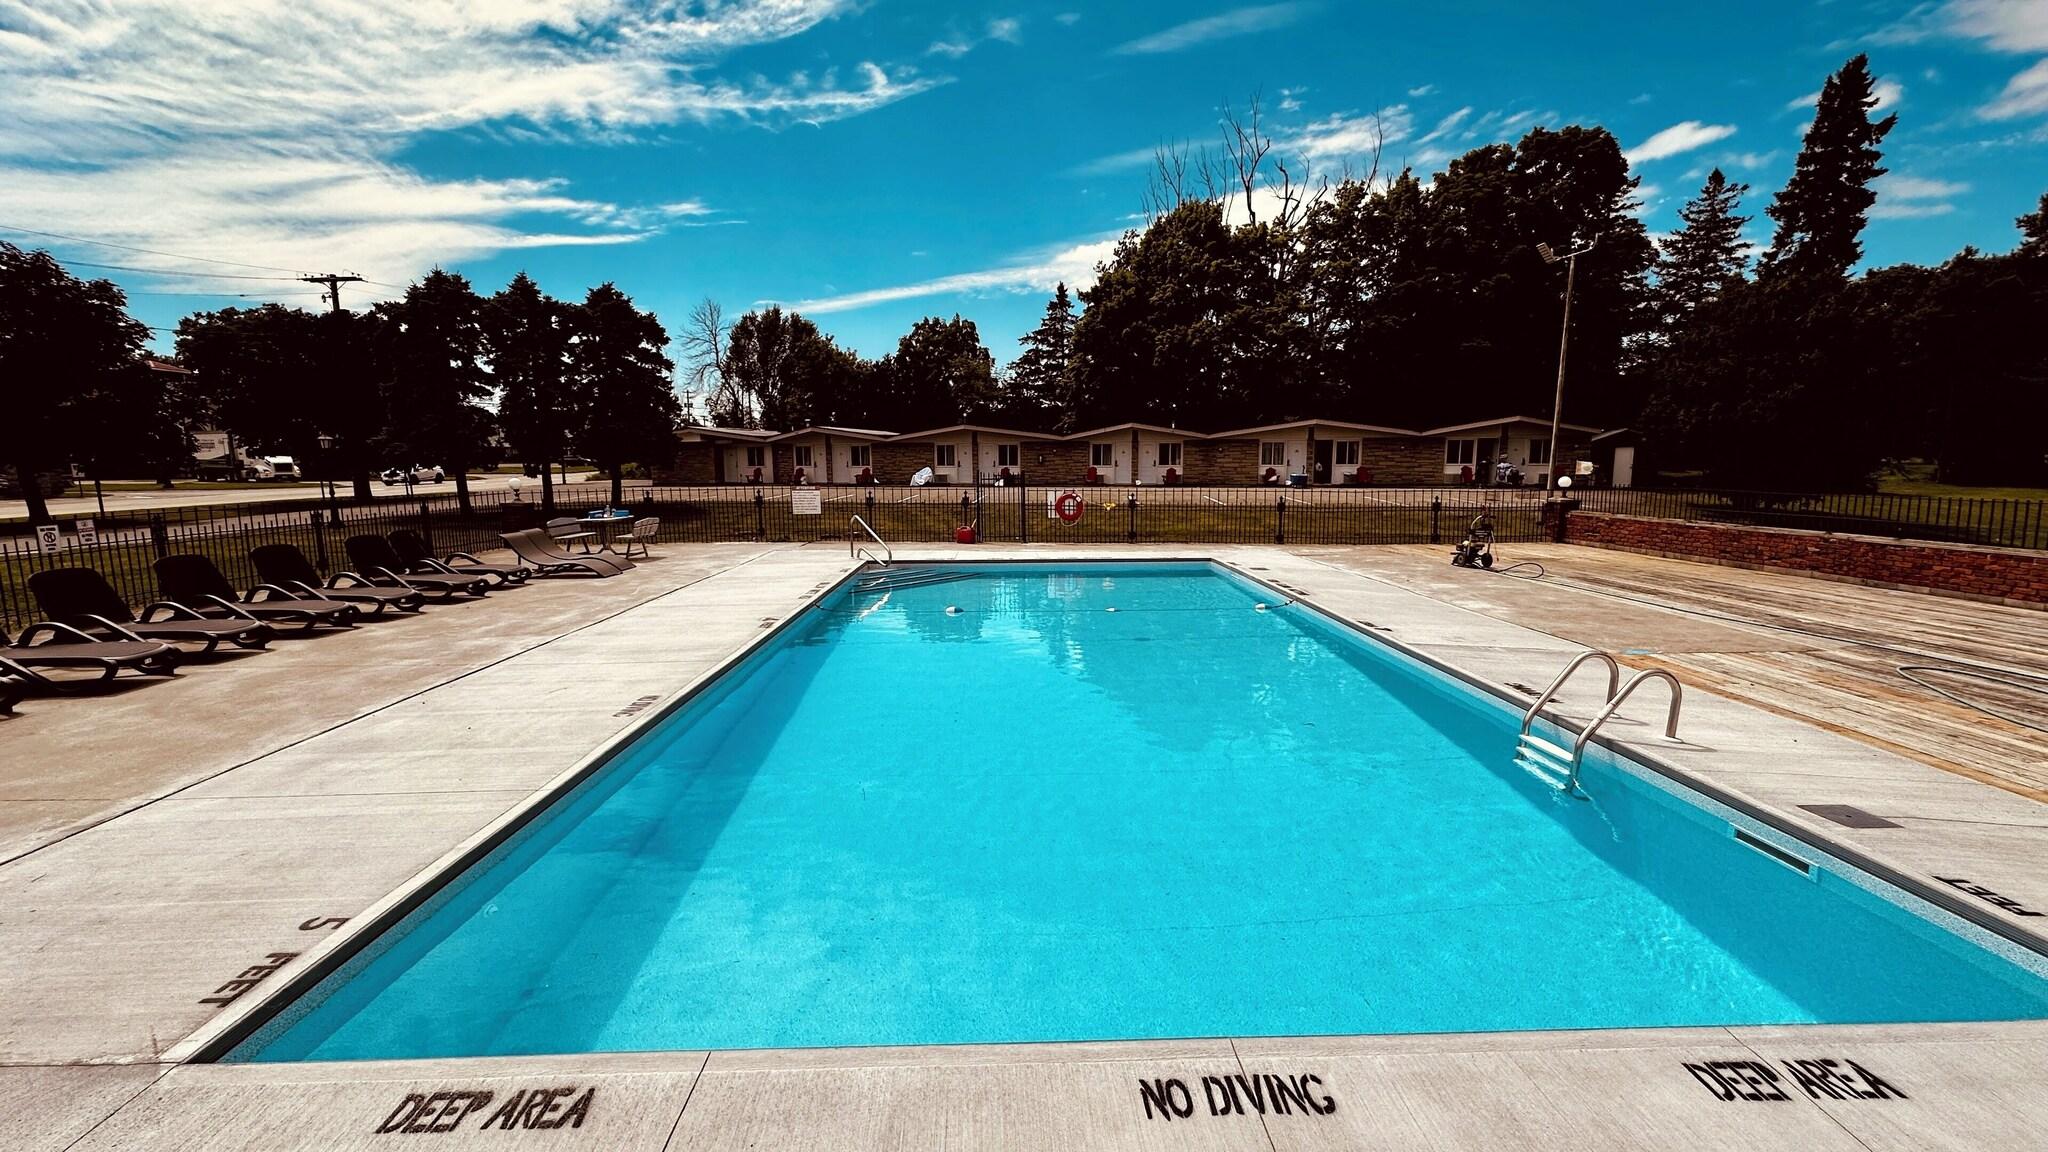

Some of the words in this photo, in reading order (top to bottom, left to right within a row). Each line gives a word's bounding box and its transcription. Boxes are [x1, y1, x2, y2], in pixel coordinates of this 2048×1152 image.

[1931, 875, 2047, 917] FEET
[298, 916, 351, 931] 5
[198, 952, 302, 1008] FEET
[1139, 1078, 1194, 1121] NO
[1201, 1073, 1336, 1116] DIVING
[1681, 1060, 1793, 1101] DEEP
[1779, 1058, 1909, 1101] AREA
[375, 1090, 494, 1134] DEEP
[479, 1087, 596, 1131] AREA
